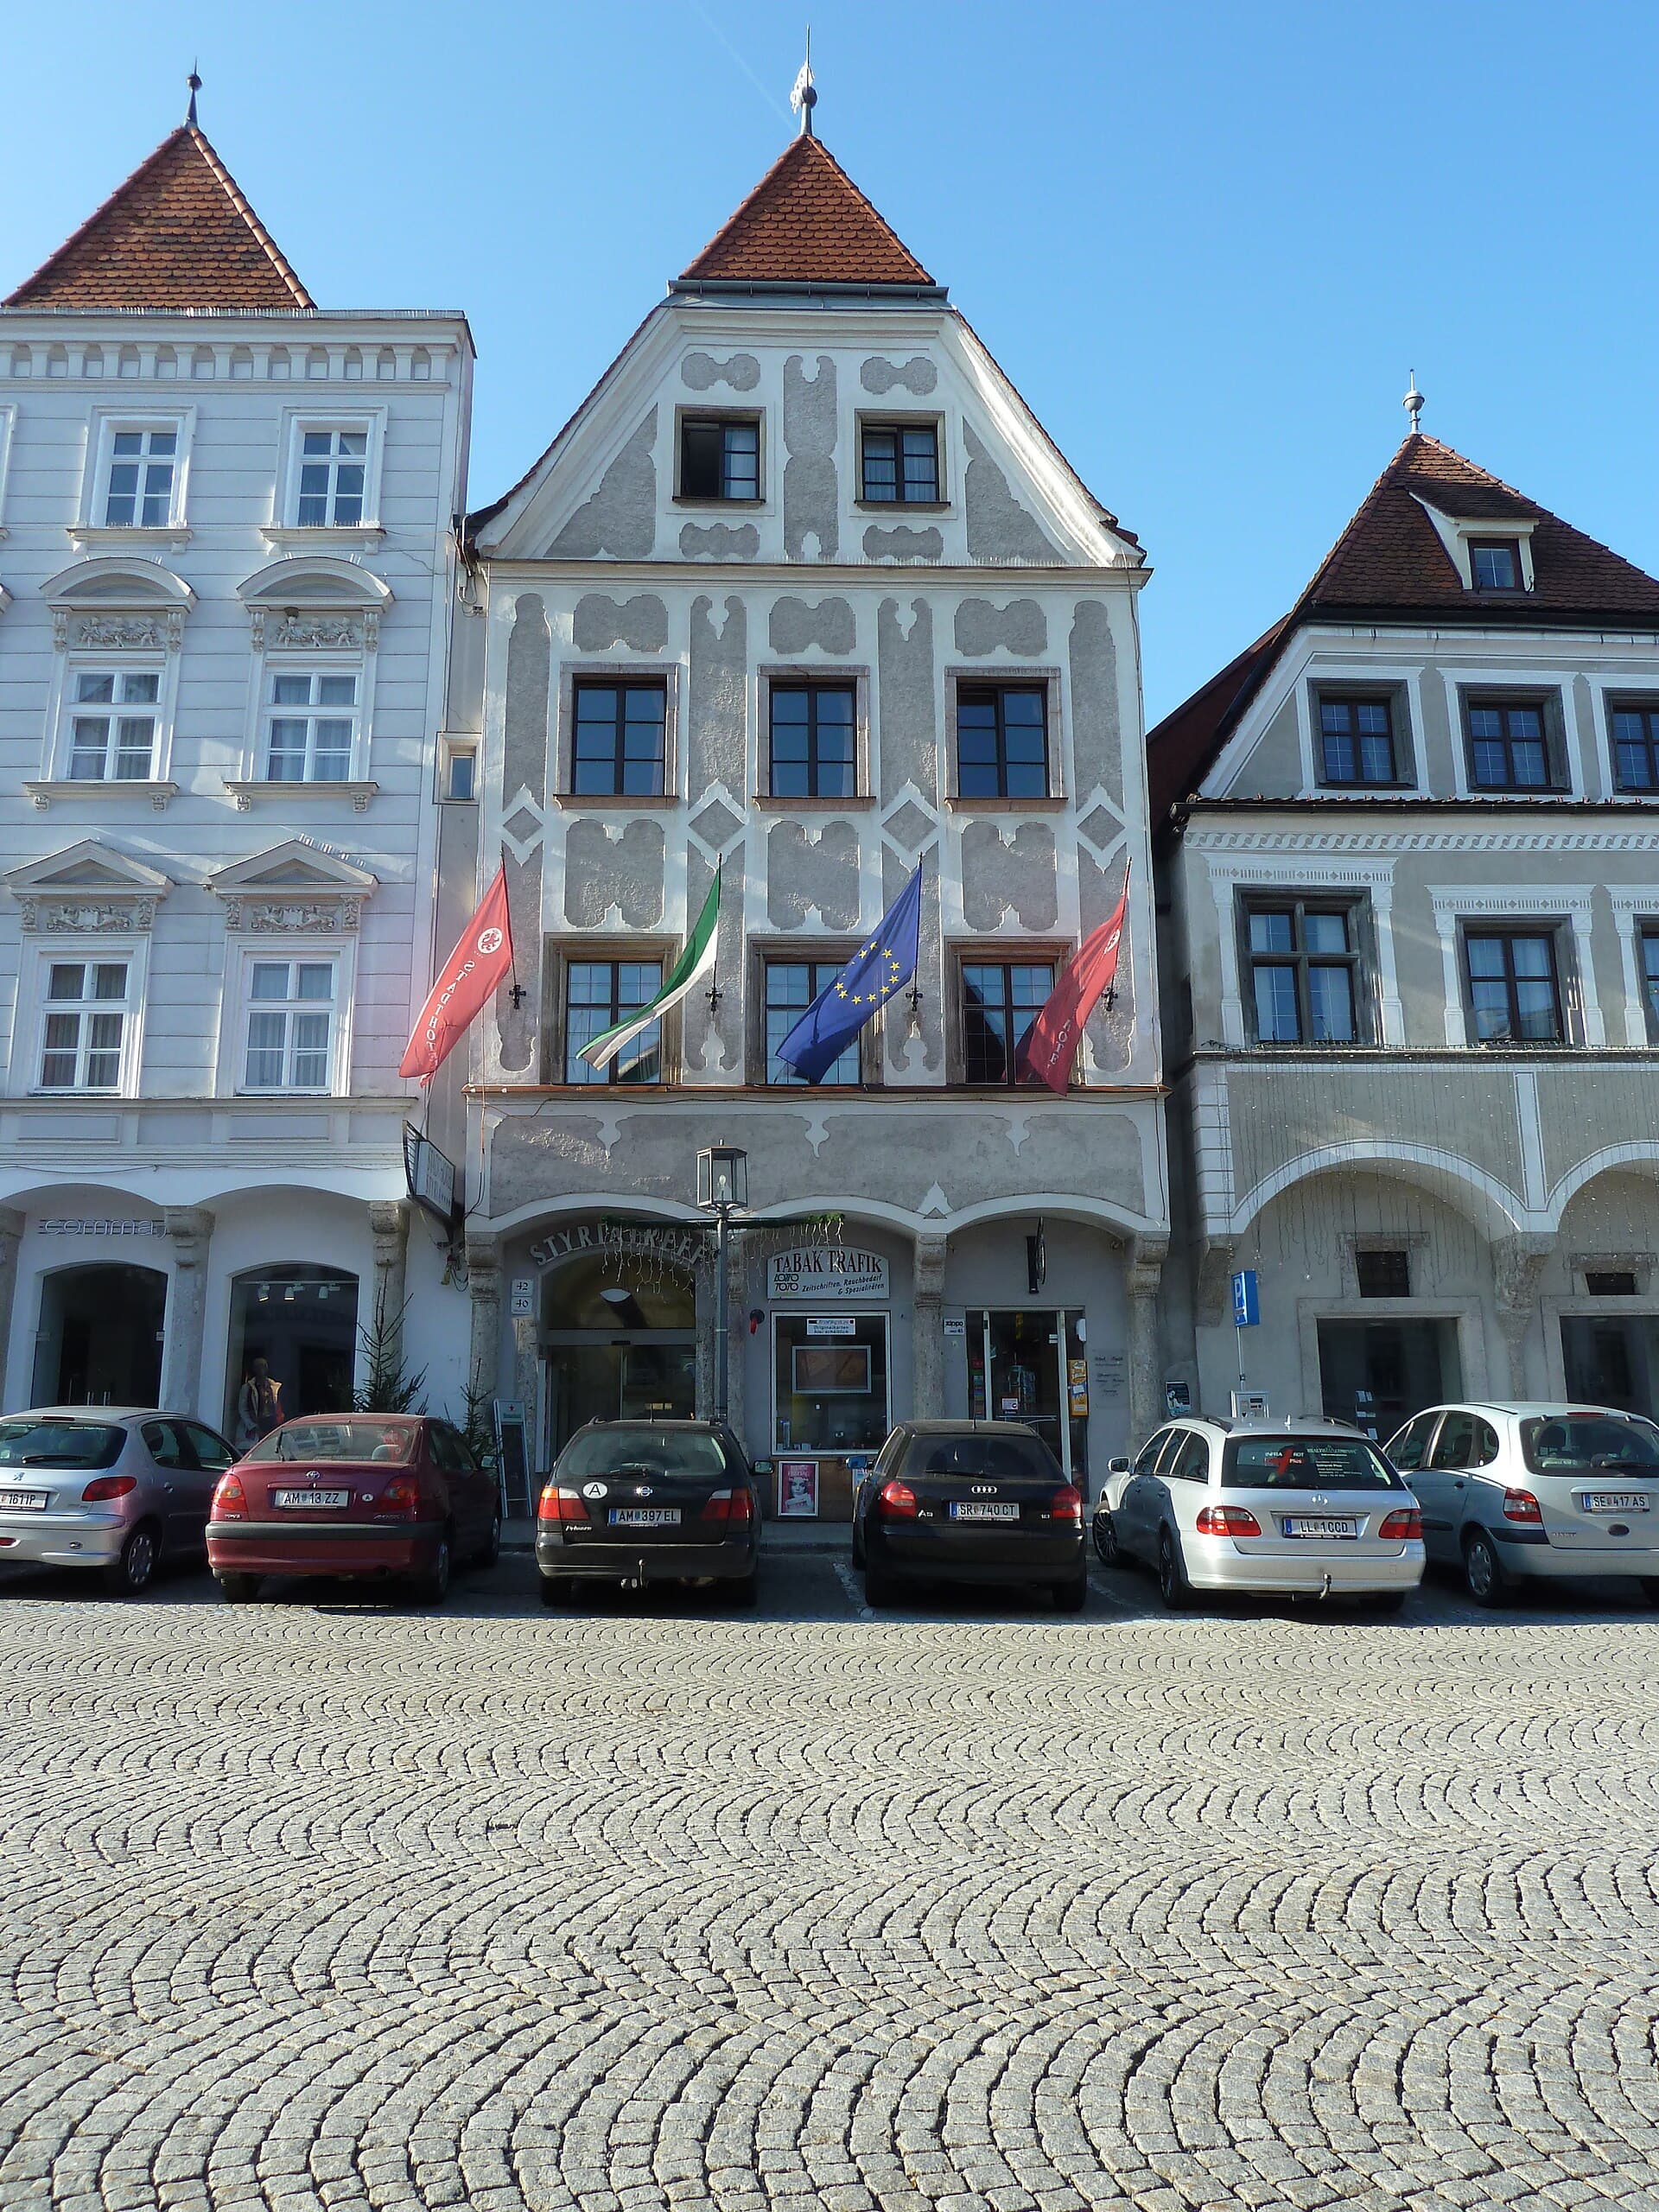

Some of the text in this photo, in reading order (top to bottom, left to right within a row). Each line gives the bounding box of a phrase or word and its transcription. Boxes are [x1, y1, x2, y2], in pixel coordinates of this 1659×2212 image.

[773, 1249, 882, 1273] TABAK TRAFIK
[774, 1274, 799, 1282] LOTTO
[517, 1281, 528, 1290] 42
[775, 1282, 798, 1291] TOTO
[1234, 1277, 1242, 1308] P
[516, 1299, 529, 1308] 40
[588, 1484, 601, 1496] A
[284, 1492, 339, 1503] AM 13 ZZ
[1593, 1497, 1645, 1507] SE 417 AS
[960, 1504, 1014, 1516] SR 740 CT
[619, 1510, 676, 1521] AM 397 EL
[1300, 1522, 1313, 1532] LL
